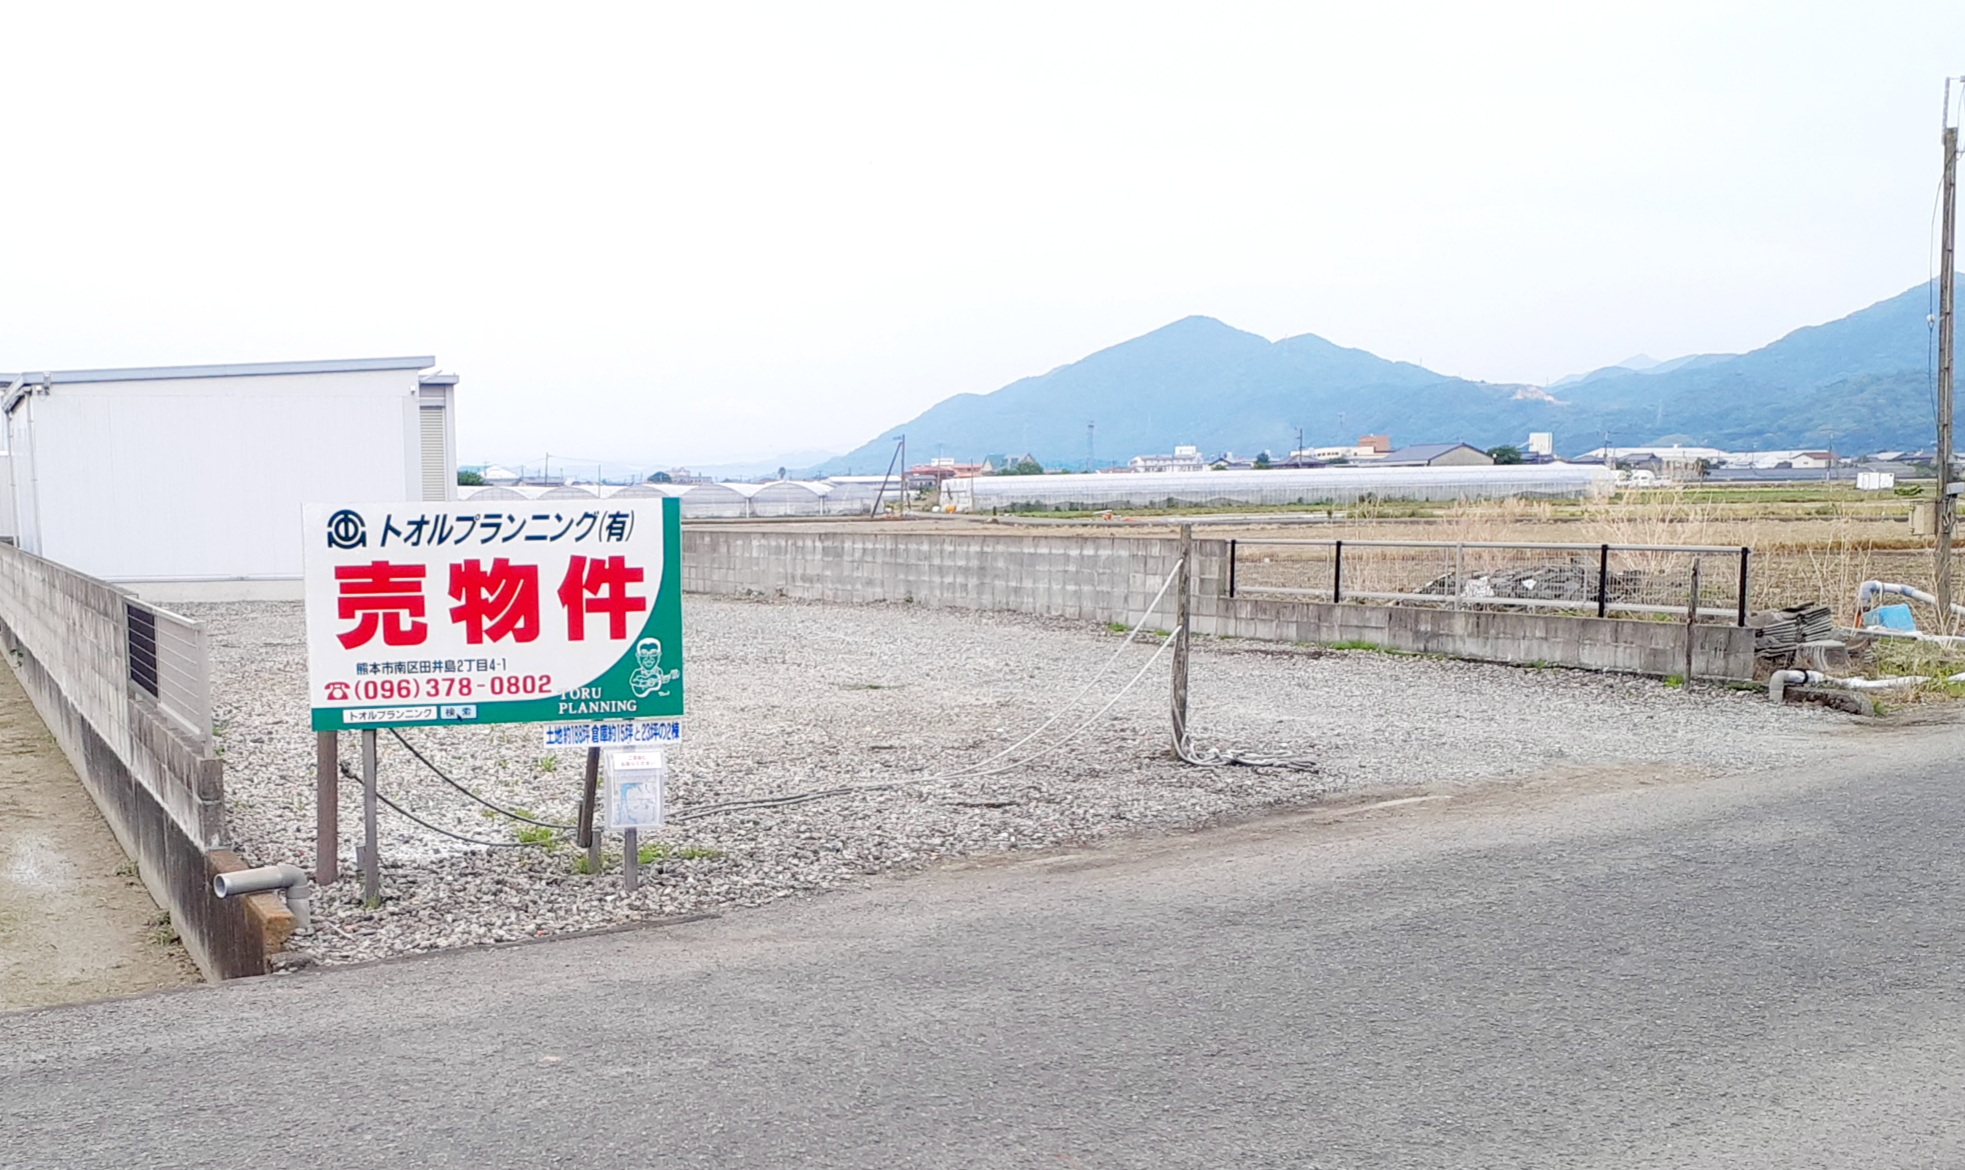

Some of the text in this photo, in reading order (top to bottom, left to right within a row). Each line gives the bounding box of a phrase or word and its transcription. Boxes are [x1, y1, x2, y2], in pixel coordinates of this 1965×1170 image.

[380, 510, 635, 548] トオルプランニング(有)
[334, 555, 647, 650] 売物件
[356, 658, 507, 675] 熊本市南区田井島2丁目4-1
[354, 675, 553, 700] (096)378-0802
[558, 687, 602, 700] TORU
[558, 700, 637, 715] PLANNING
